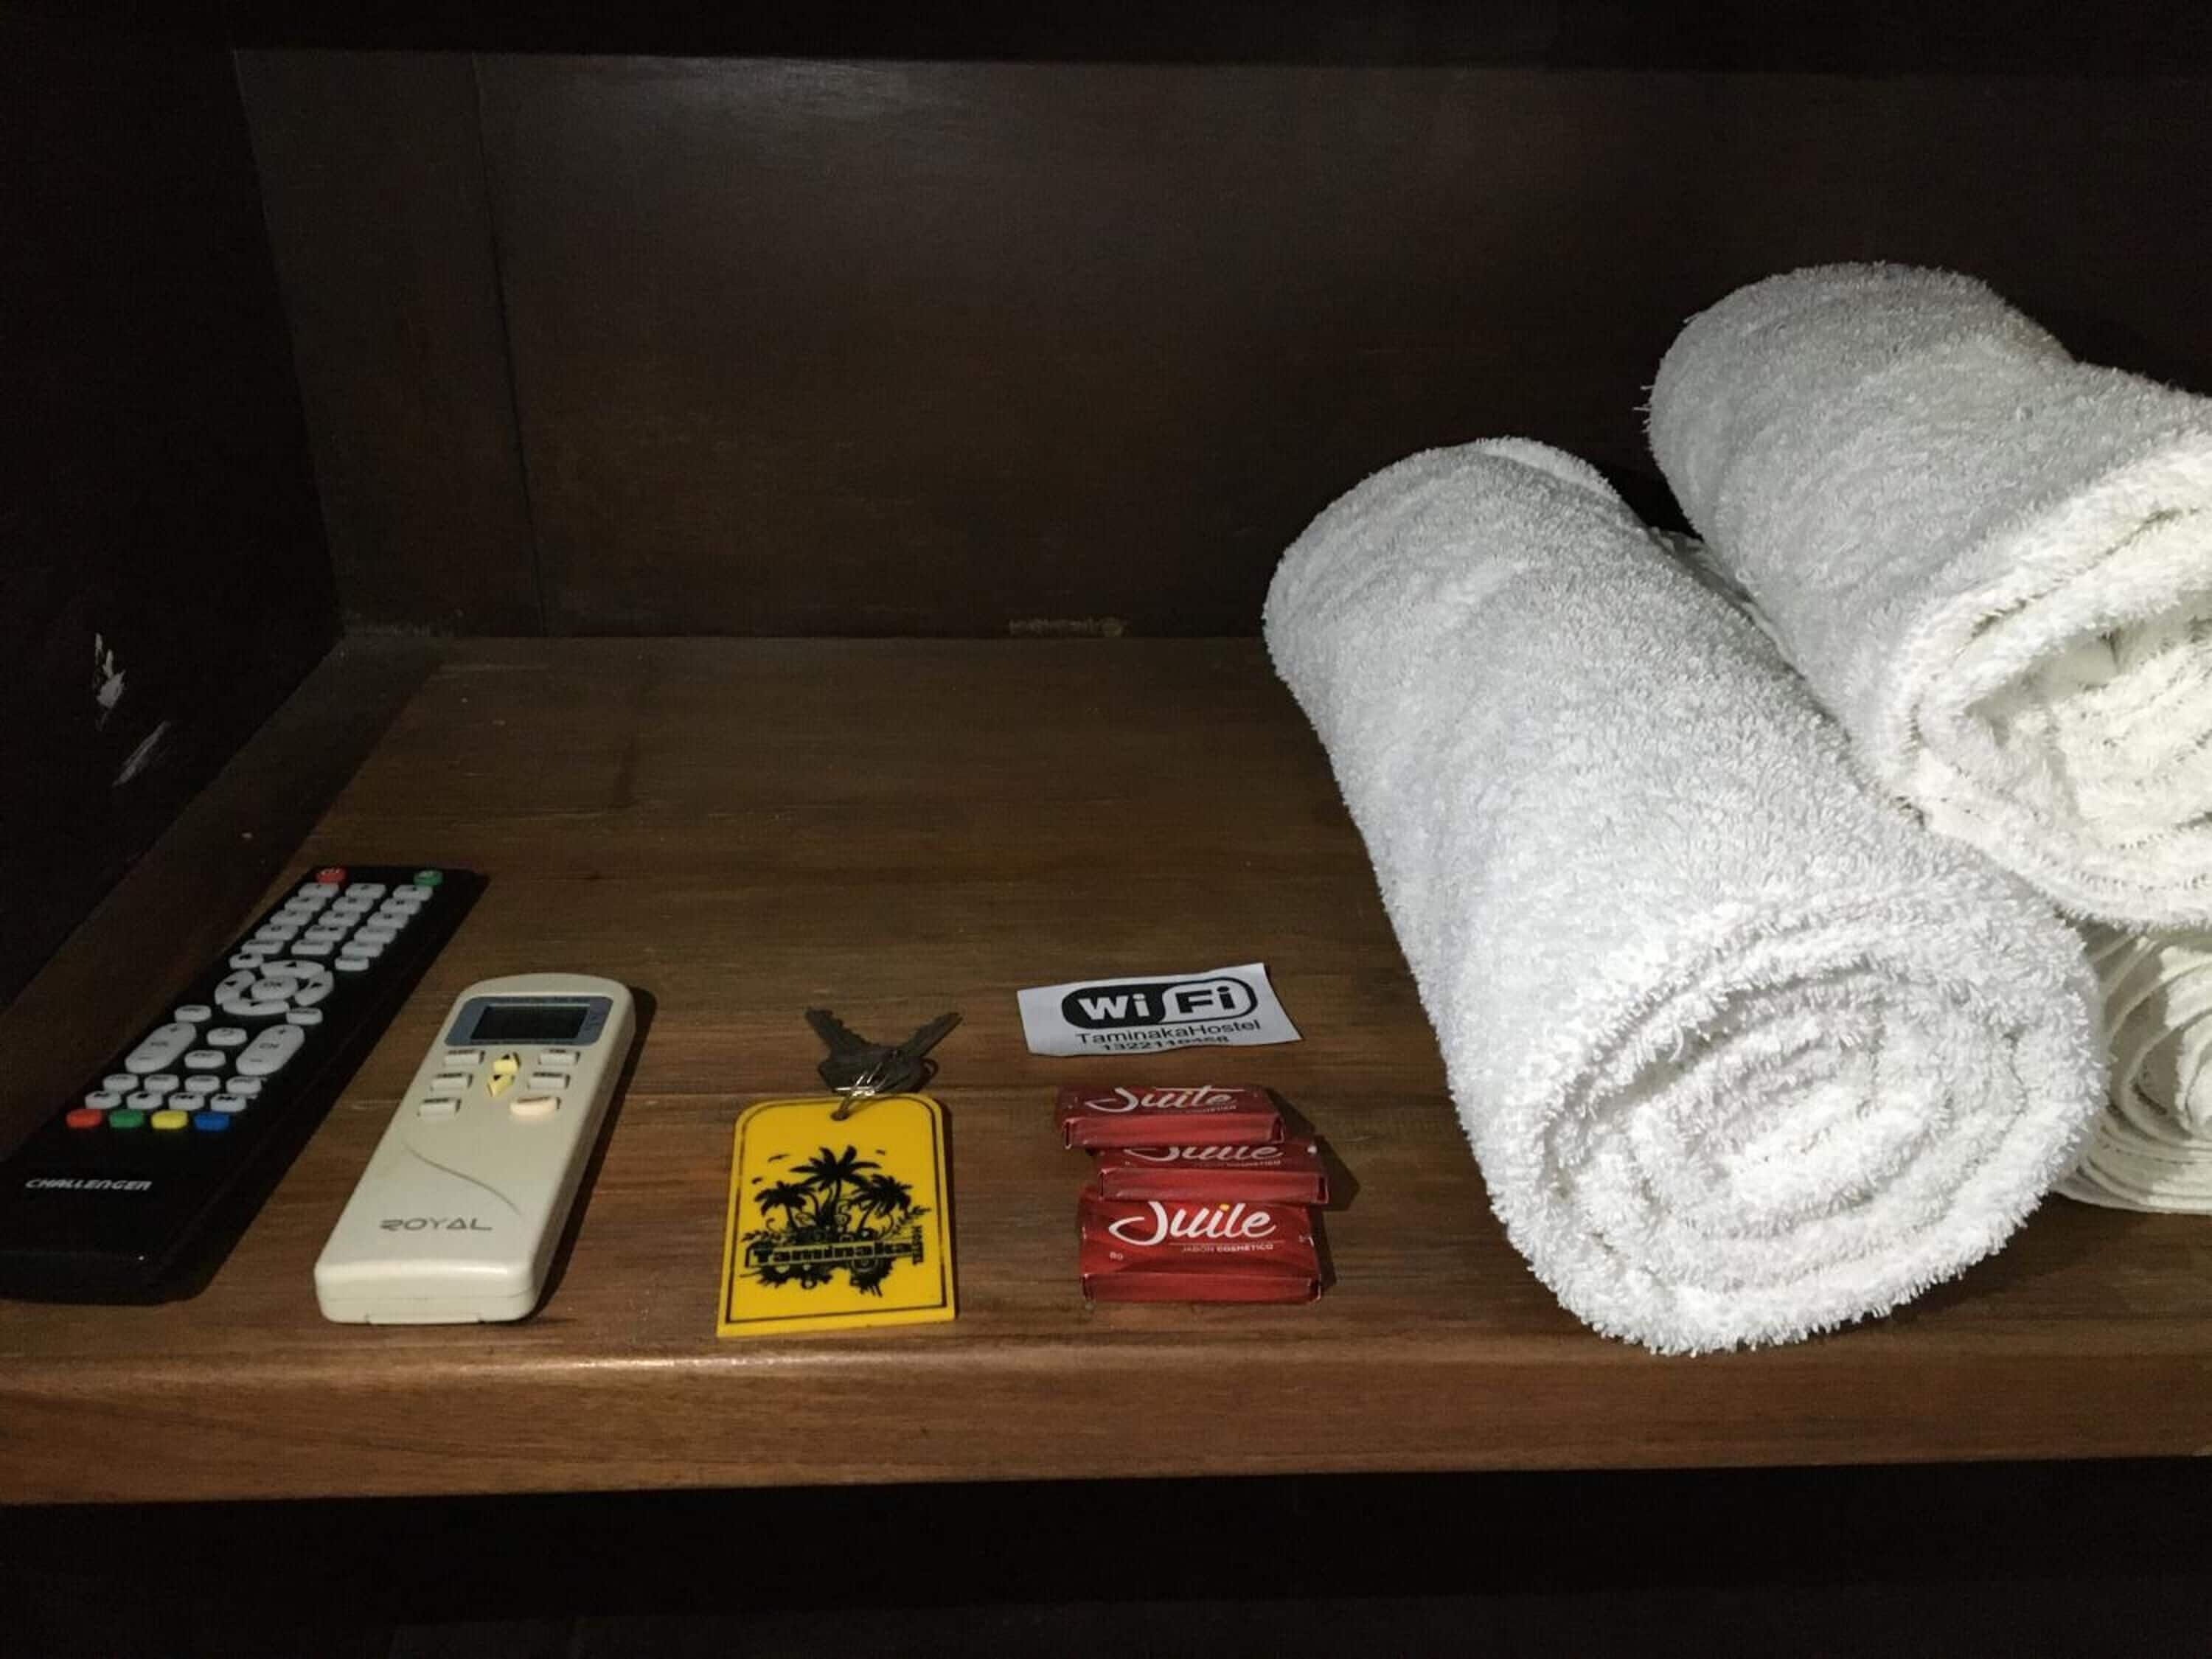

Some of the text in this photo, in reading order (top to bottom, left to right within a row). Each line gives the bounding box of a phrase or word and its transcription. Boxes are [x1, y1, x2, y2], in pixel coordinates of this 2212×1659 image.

[1075, 1019, 1261, 1045] TaminakaHostel
[25, 1179, 153, 1192] CHALLENGER
[379, 1217, 493, 1232] ROYAL
[1108, 1200, 1277, 1246] Juile
